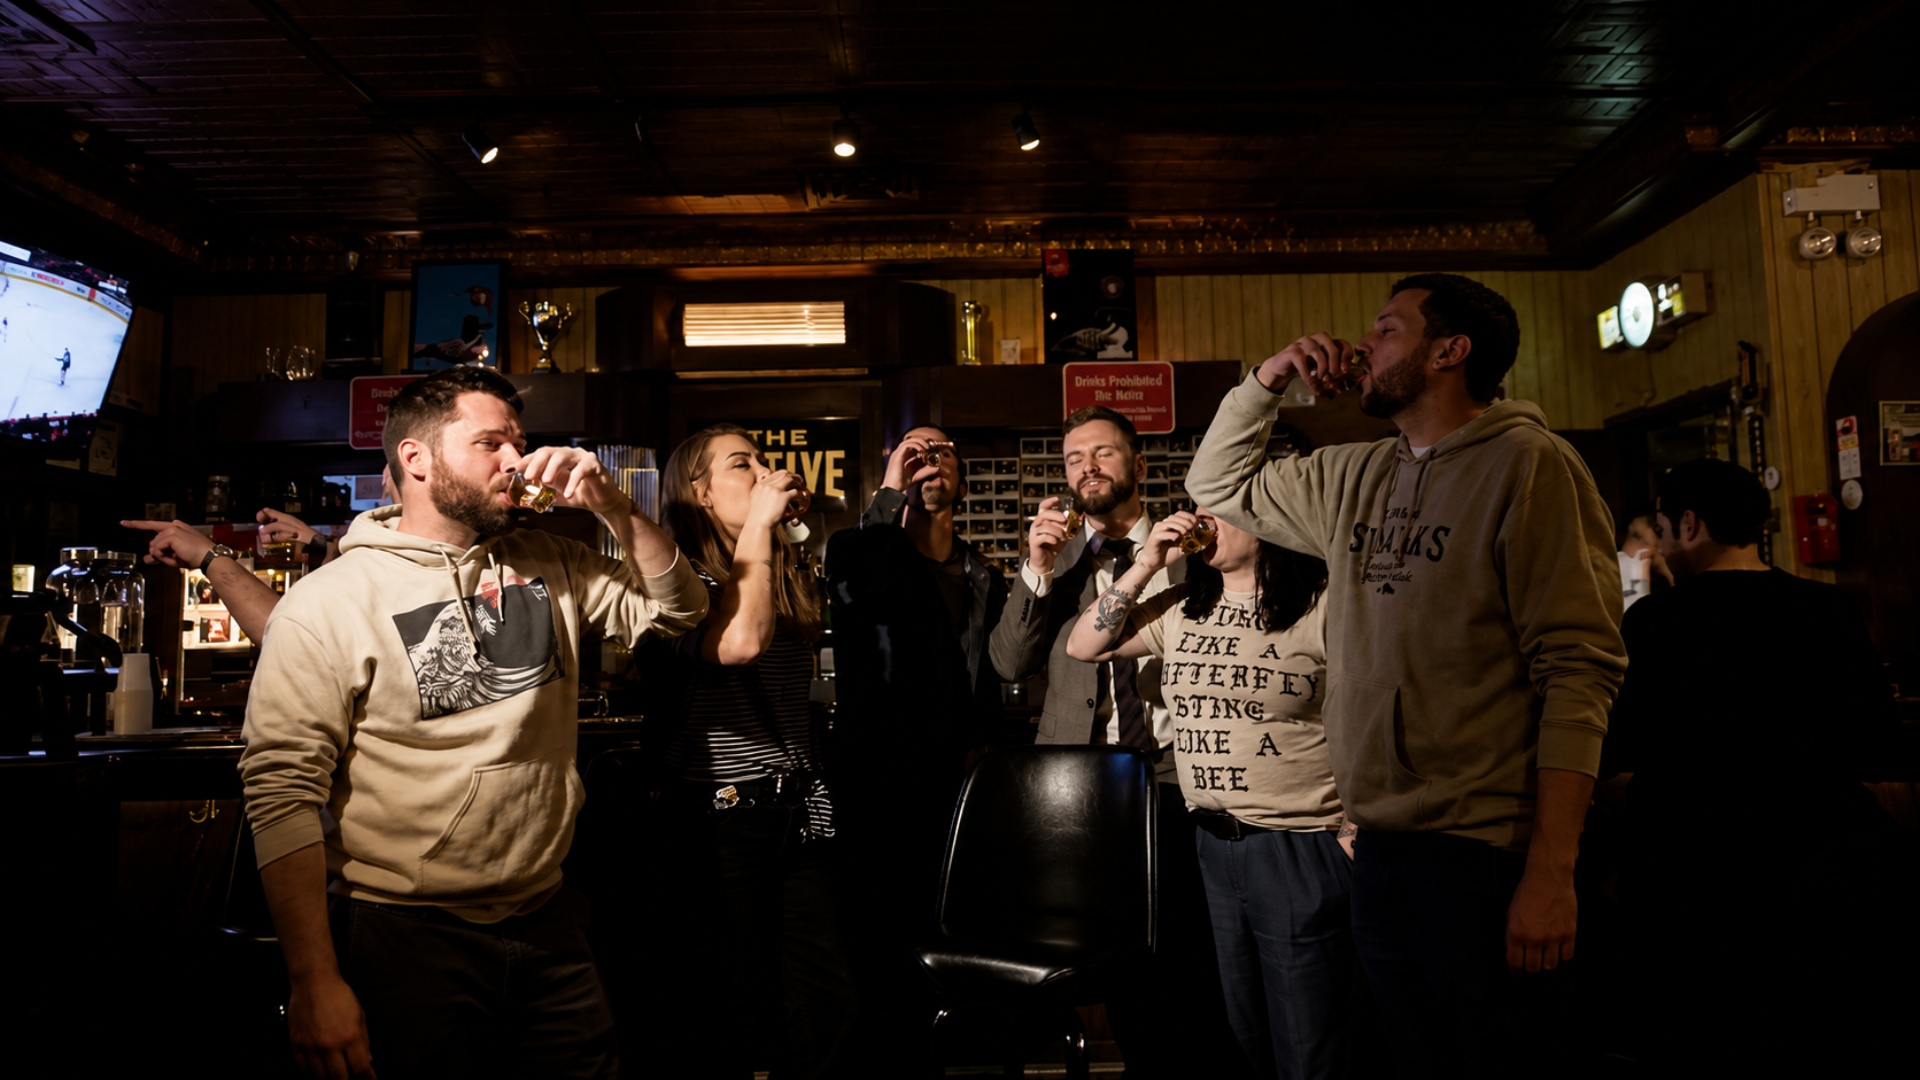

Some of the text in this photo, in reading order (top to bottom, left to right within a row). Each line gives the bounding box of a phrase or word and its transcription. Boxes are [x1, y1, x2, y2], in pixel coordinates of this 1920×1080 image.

[1075, 375, 1106, 387] Drinks
[746, 429, 808, 446] THE
[1176, 631, 1281, 660] LIKE A
[1172, 694, 1265, 721] STING
[1175, 728, 1282, 757] LIKE A
[1191, 763, 1249, 792] BEE
